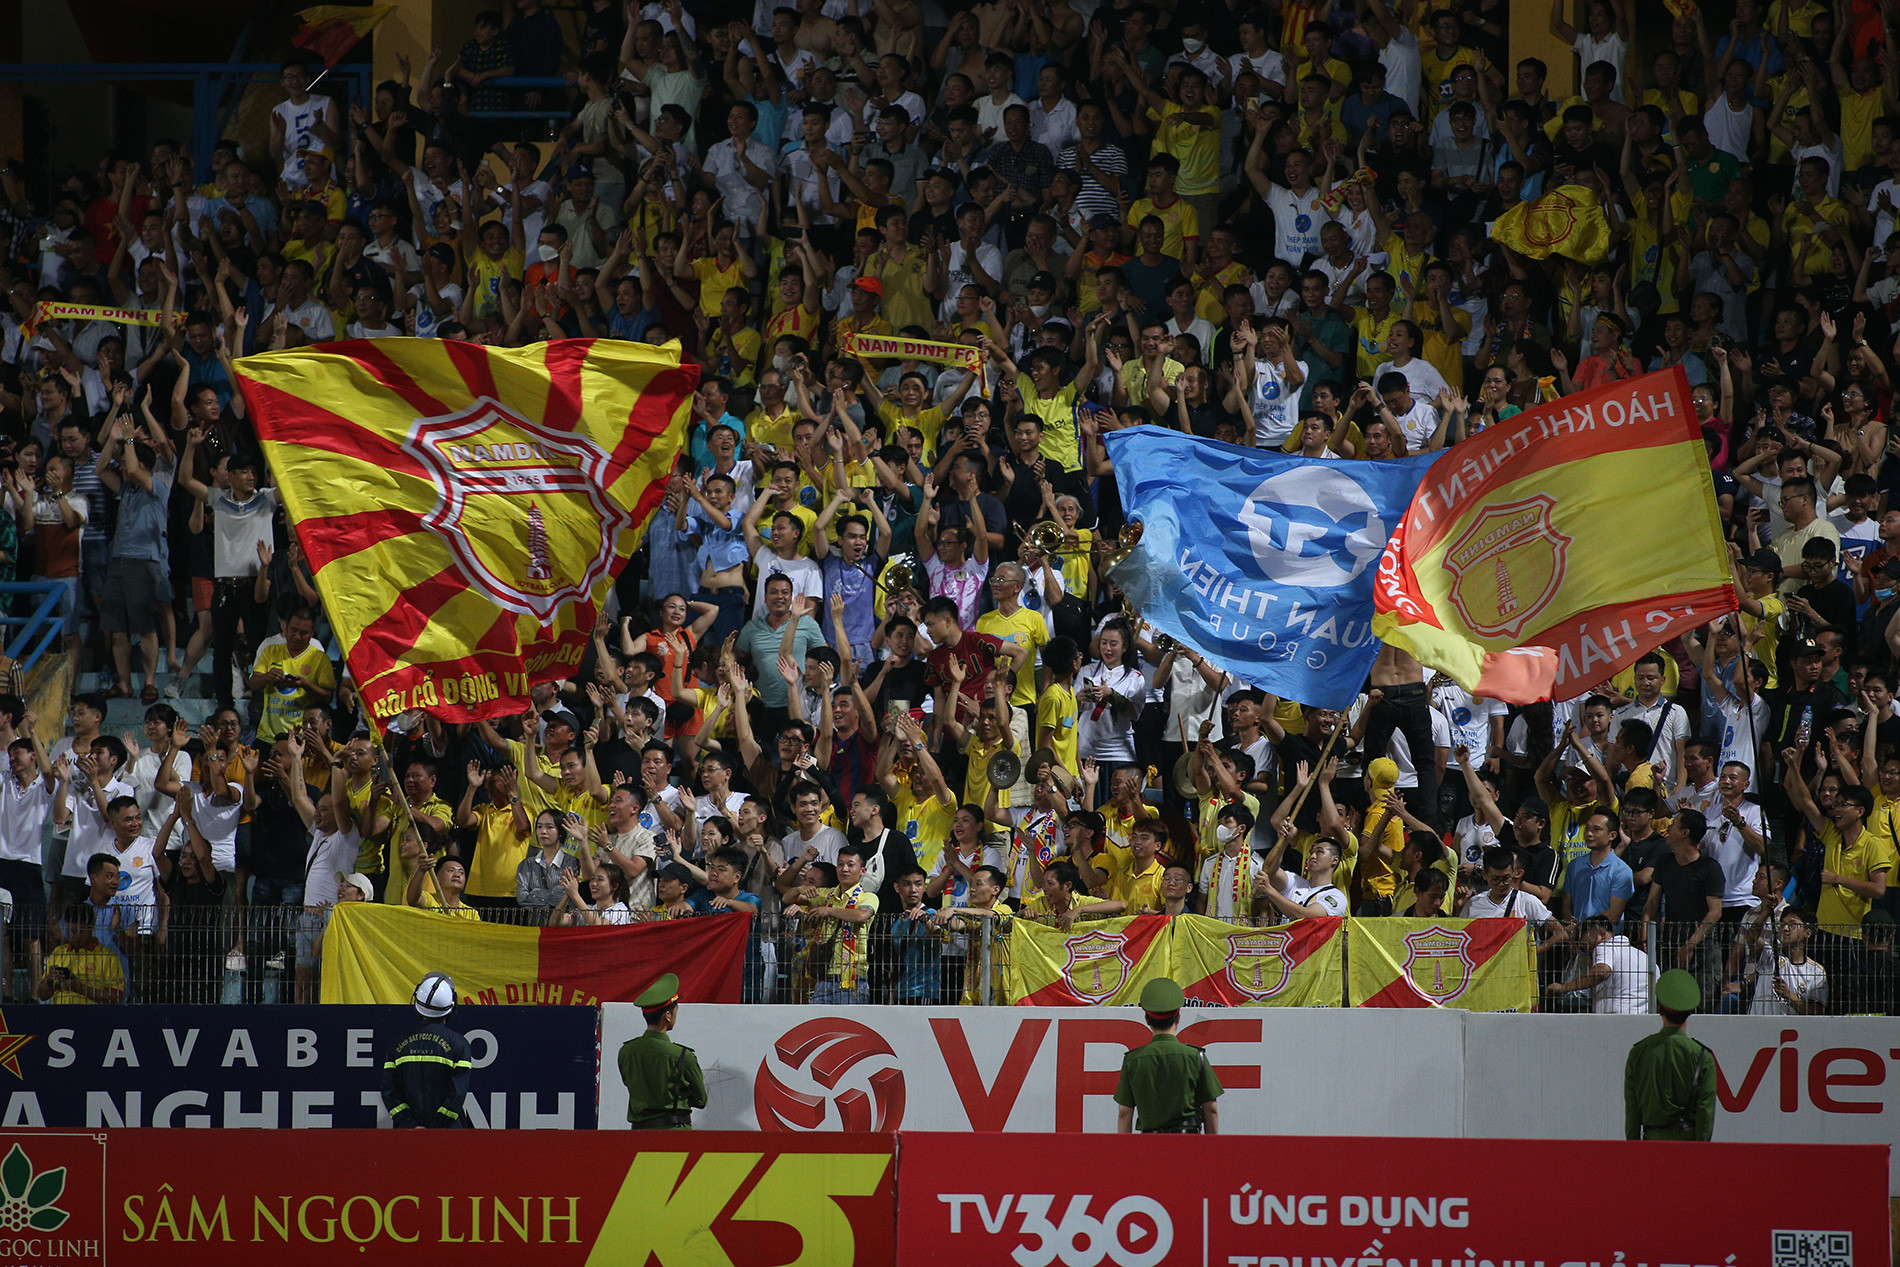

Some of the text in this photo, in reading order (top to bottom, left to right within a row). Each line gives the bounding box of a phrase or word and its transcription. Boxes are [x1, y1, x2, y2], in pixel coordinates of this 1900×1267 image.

[54, 306, 96, 316] NAM
[102, 309, 148, 321] DINH
[858, 338, 976, 362] NAM DINH FC
[450, 441, 570, 463] NAMDIN
[512, 475, 540, 486] 1965
[442, 671, 499, 711] ĐỘNG
[1076, 943, 1118, 952] NAMDINH
[464, 982, 598, 1006] AM DINH FA
[47, 1028, 499, 1068] SAVABEO
[1711, 1029, 1900, 1114] vie
[361, 1091, 575, 1129] TNH
[123, 1182, 582, 1252] SÂM NGỌC LINH
[584, 1152, 892, 1267] K5
[1229, 1182, 1469, 1234] ỨNG DỤNG
[48, 1239, 99, 1257] LINH
[937, 1194, 1174, 1267] TV360
